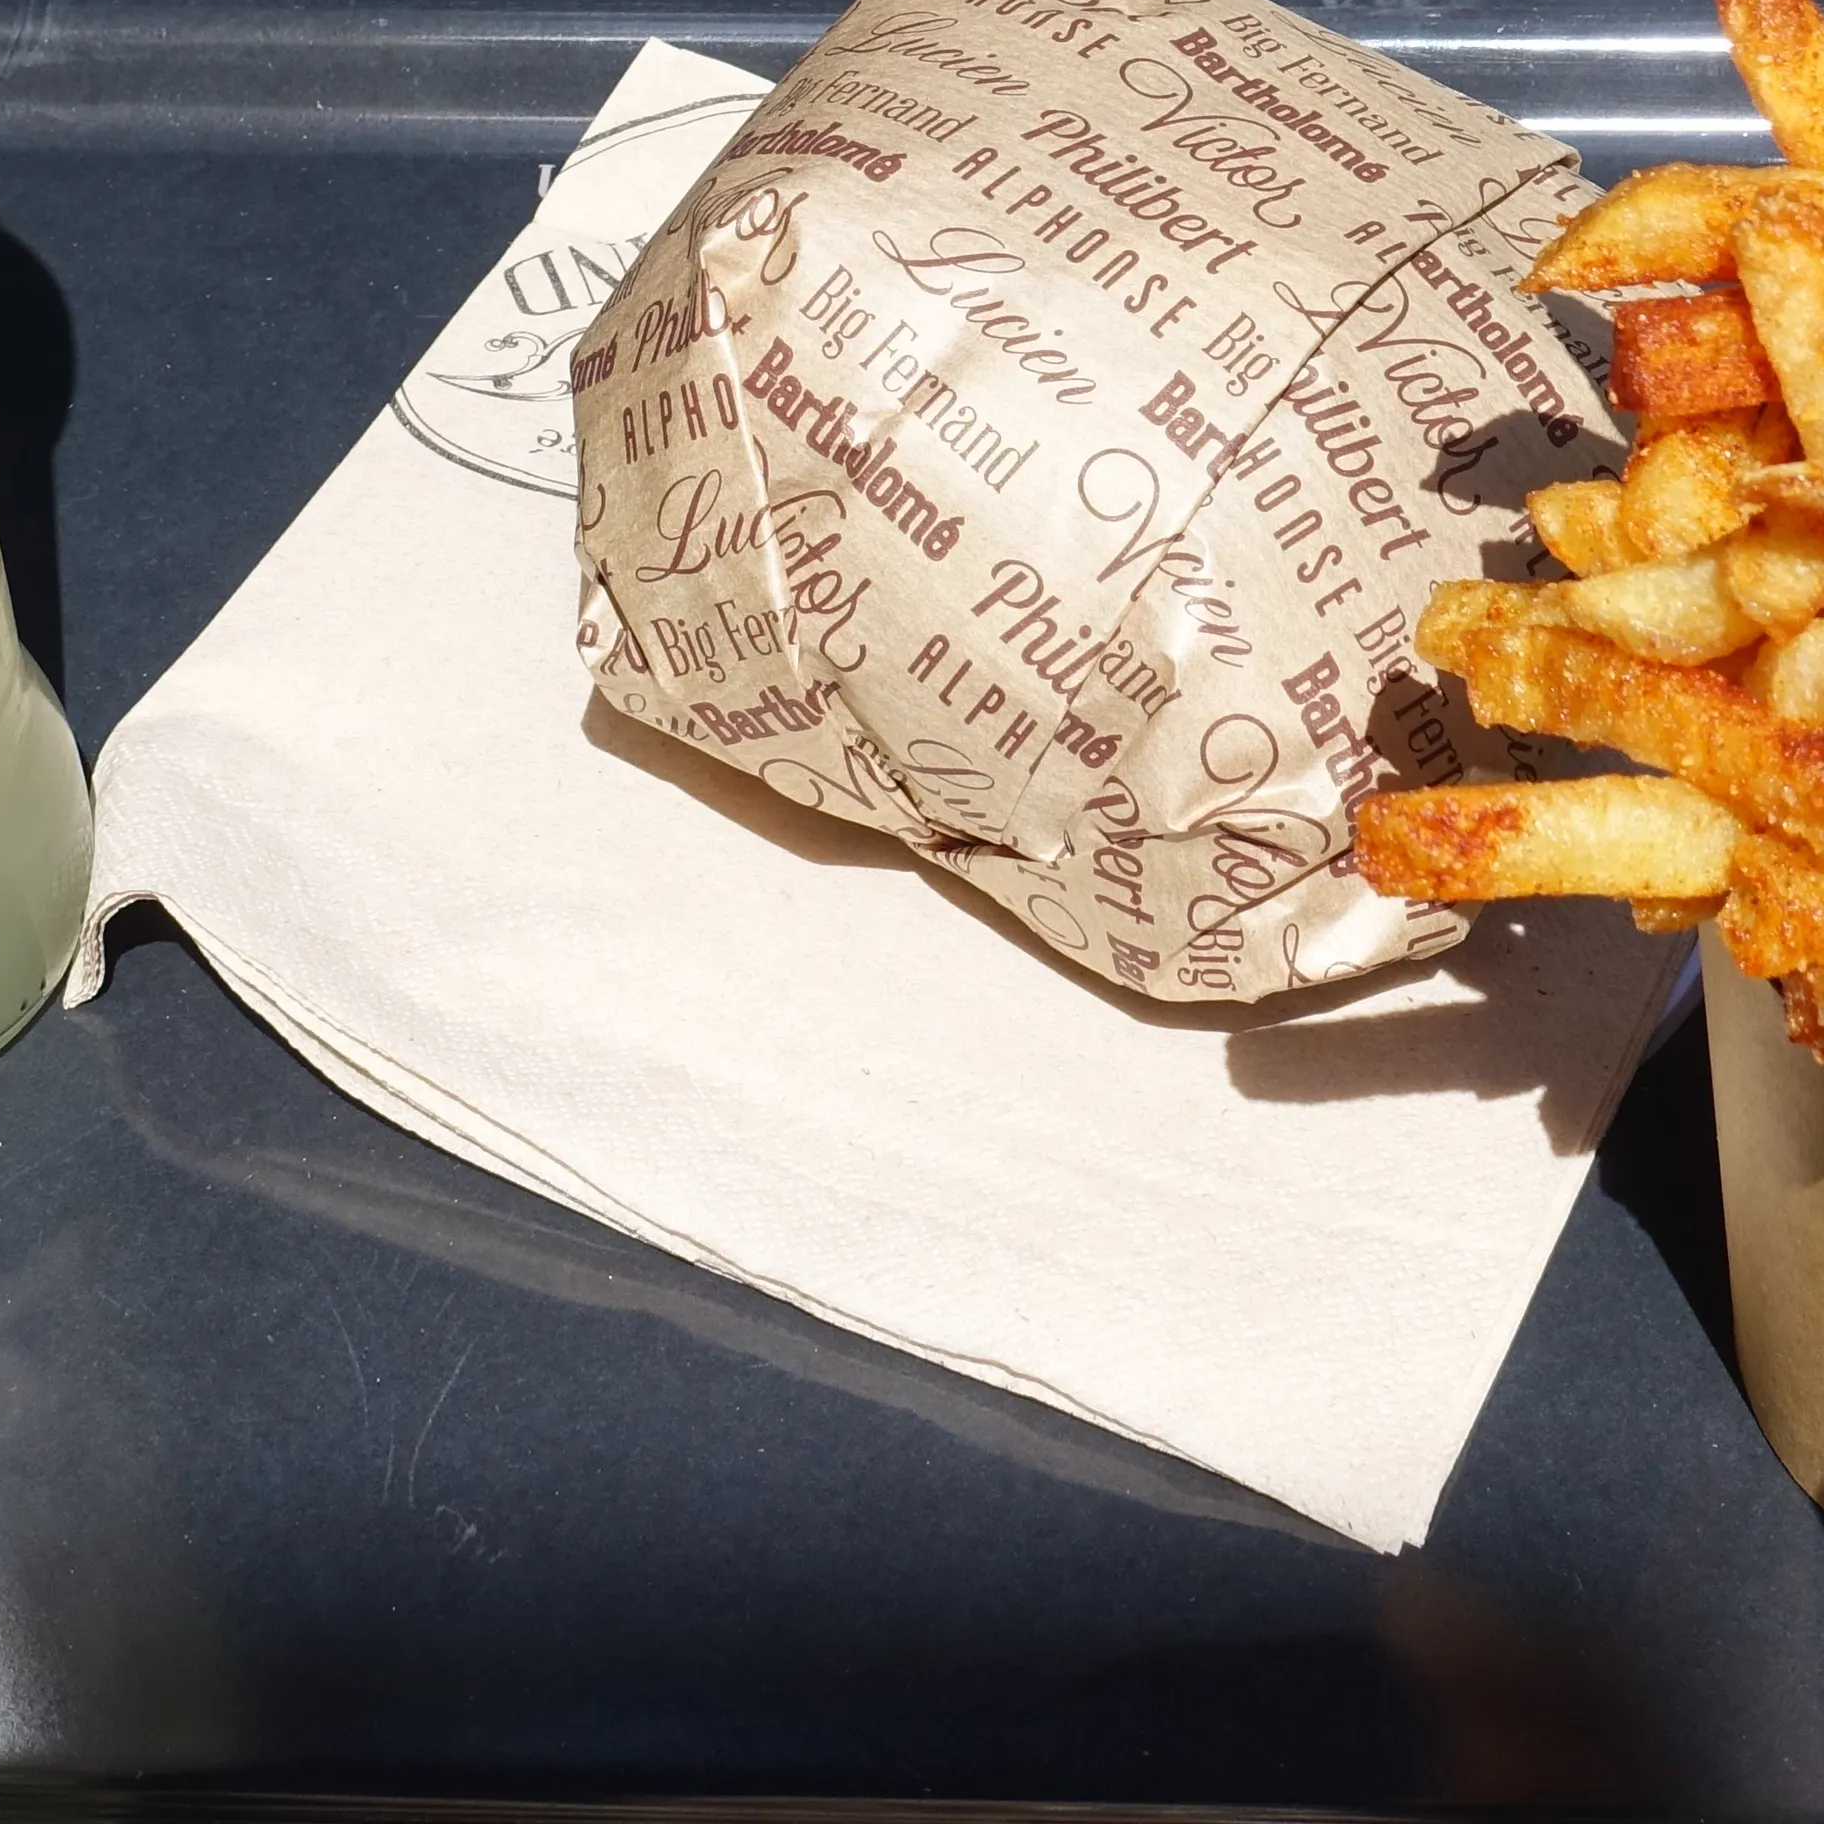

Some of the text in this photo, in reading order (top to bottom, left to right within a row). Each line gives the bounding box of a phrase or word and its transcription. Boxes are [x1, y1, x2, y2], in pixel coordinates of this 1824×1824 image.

[818, 70, 978, 143] Fernand
[825, 11, 1030, 96] Lucien
[1170, 27, 1391, 184] Bartholomé
[1220, 13, 1286, 59] Big
[1277, 53, 1445, 166] Fernand
[1020, 109, 1259, 275] Philibert
[1120, 57, 1307, 228] Victor
[873, 227, 1098, 405] Lucien
[951, 147, 1197, 339] ALPHONSE
[799, 264, 876, 360] Big
[859, 319, 1041, 494] Fernand
[1201, 312, 1280, 397] Big
[1355, 274, 1500, 517] Victor
[743, 336, 965, 561] Bartholomé
[651, 618, 726, 683] Big
[1354, 604, 1419, 698] Big
